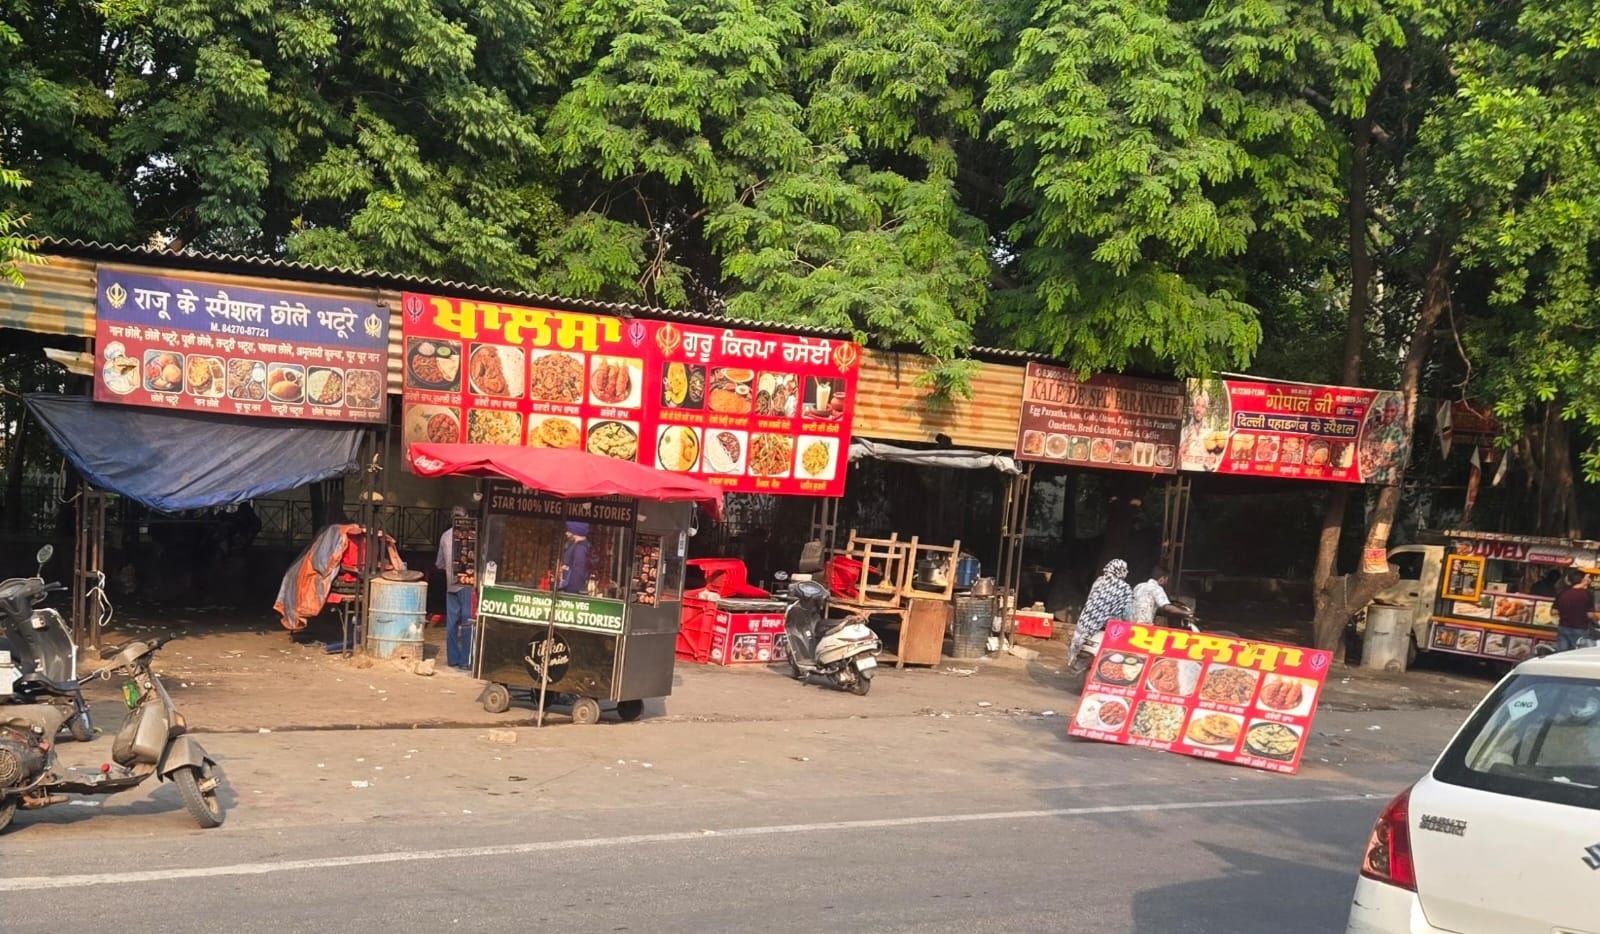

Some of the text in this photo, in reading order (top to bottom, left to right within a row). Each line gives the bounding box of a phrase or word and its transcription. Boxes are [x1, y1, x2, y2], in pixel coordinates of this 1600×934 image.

[134, 288, 171, 320] राजू
[176, 289, 199, 314] के
[204, 290, 265, 323] स्पैशल
[270, 301, 311, 328] छोले
[317, 307, 358, 339] भटूरे
[430, 297, 623, 352] ਖਾਲਸਾ
[109, 325, 123, 337] नान
[125, 327, 142, 341] छोले,
[144, 329, 160, 341] छोले
[210, 323, 269, 338] M. 84270-87721
[683, 329, 832, 365] ਗੁਰੂ ਕਿਰਪਾ ਰਸੋਈ
[1031, 380, 1064, 403] KALE
[1068, 385, 1086, 406] DE
[1266, 388, 1333, 413] गोपाल जी
[1030, 405, 1041, 417] Egg
[1237, 413, 1265, 428] दिल्ली
[1311, 419, 1322, 433] के
[492, 495, 514, 510] STAR
[517, 498, 541, 512] 100%
[544, 501, 562, 515] VEG
[593, 505, 632, 521] STORIES
[481, 599, 508, 615] SOYA
[509, 603, 545, 619] CHAAP
[577, 609, 622, 629] STORIES
[513, 594, 531, 604] STAR
[576, 601, 590, 611] VEG
[1128, 625, 1304, 671] ਖਾਲਸਾ
[1513, 700, 1533, 709] CNG
[1421, 814, 1468, 829] MARUTI
